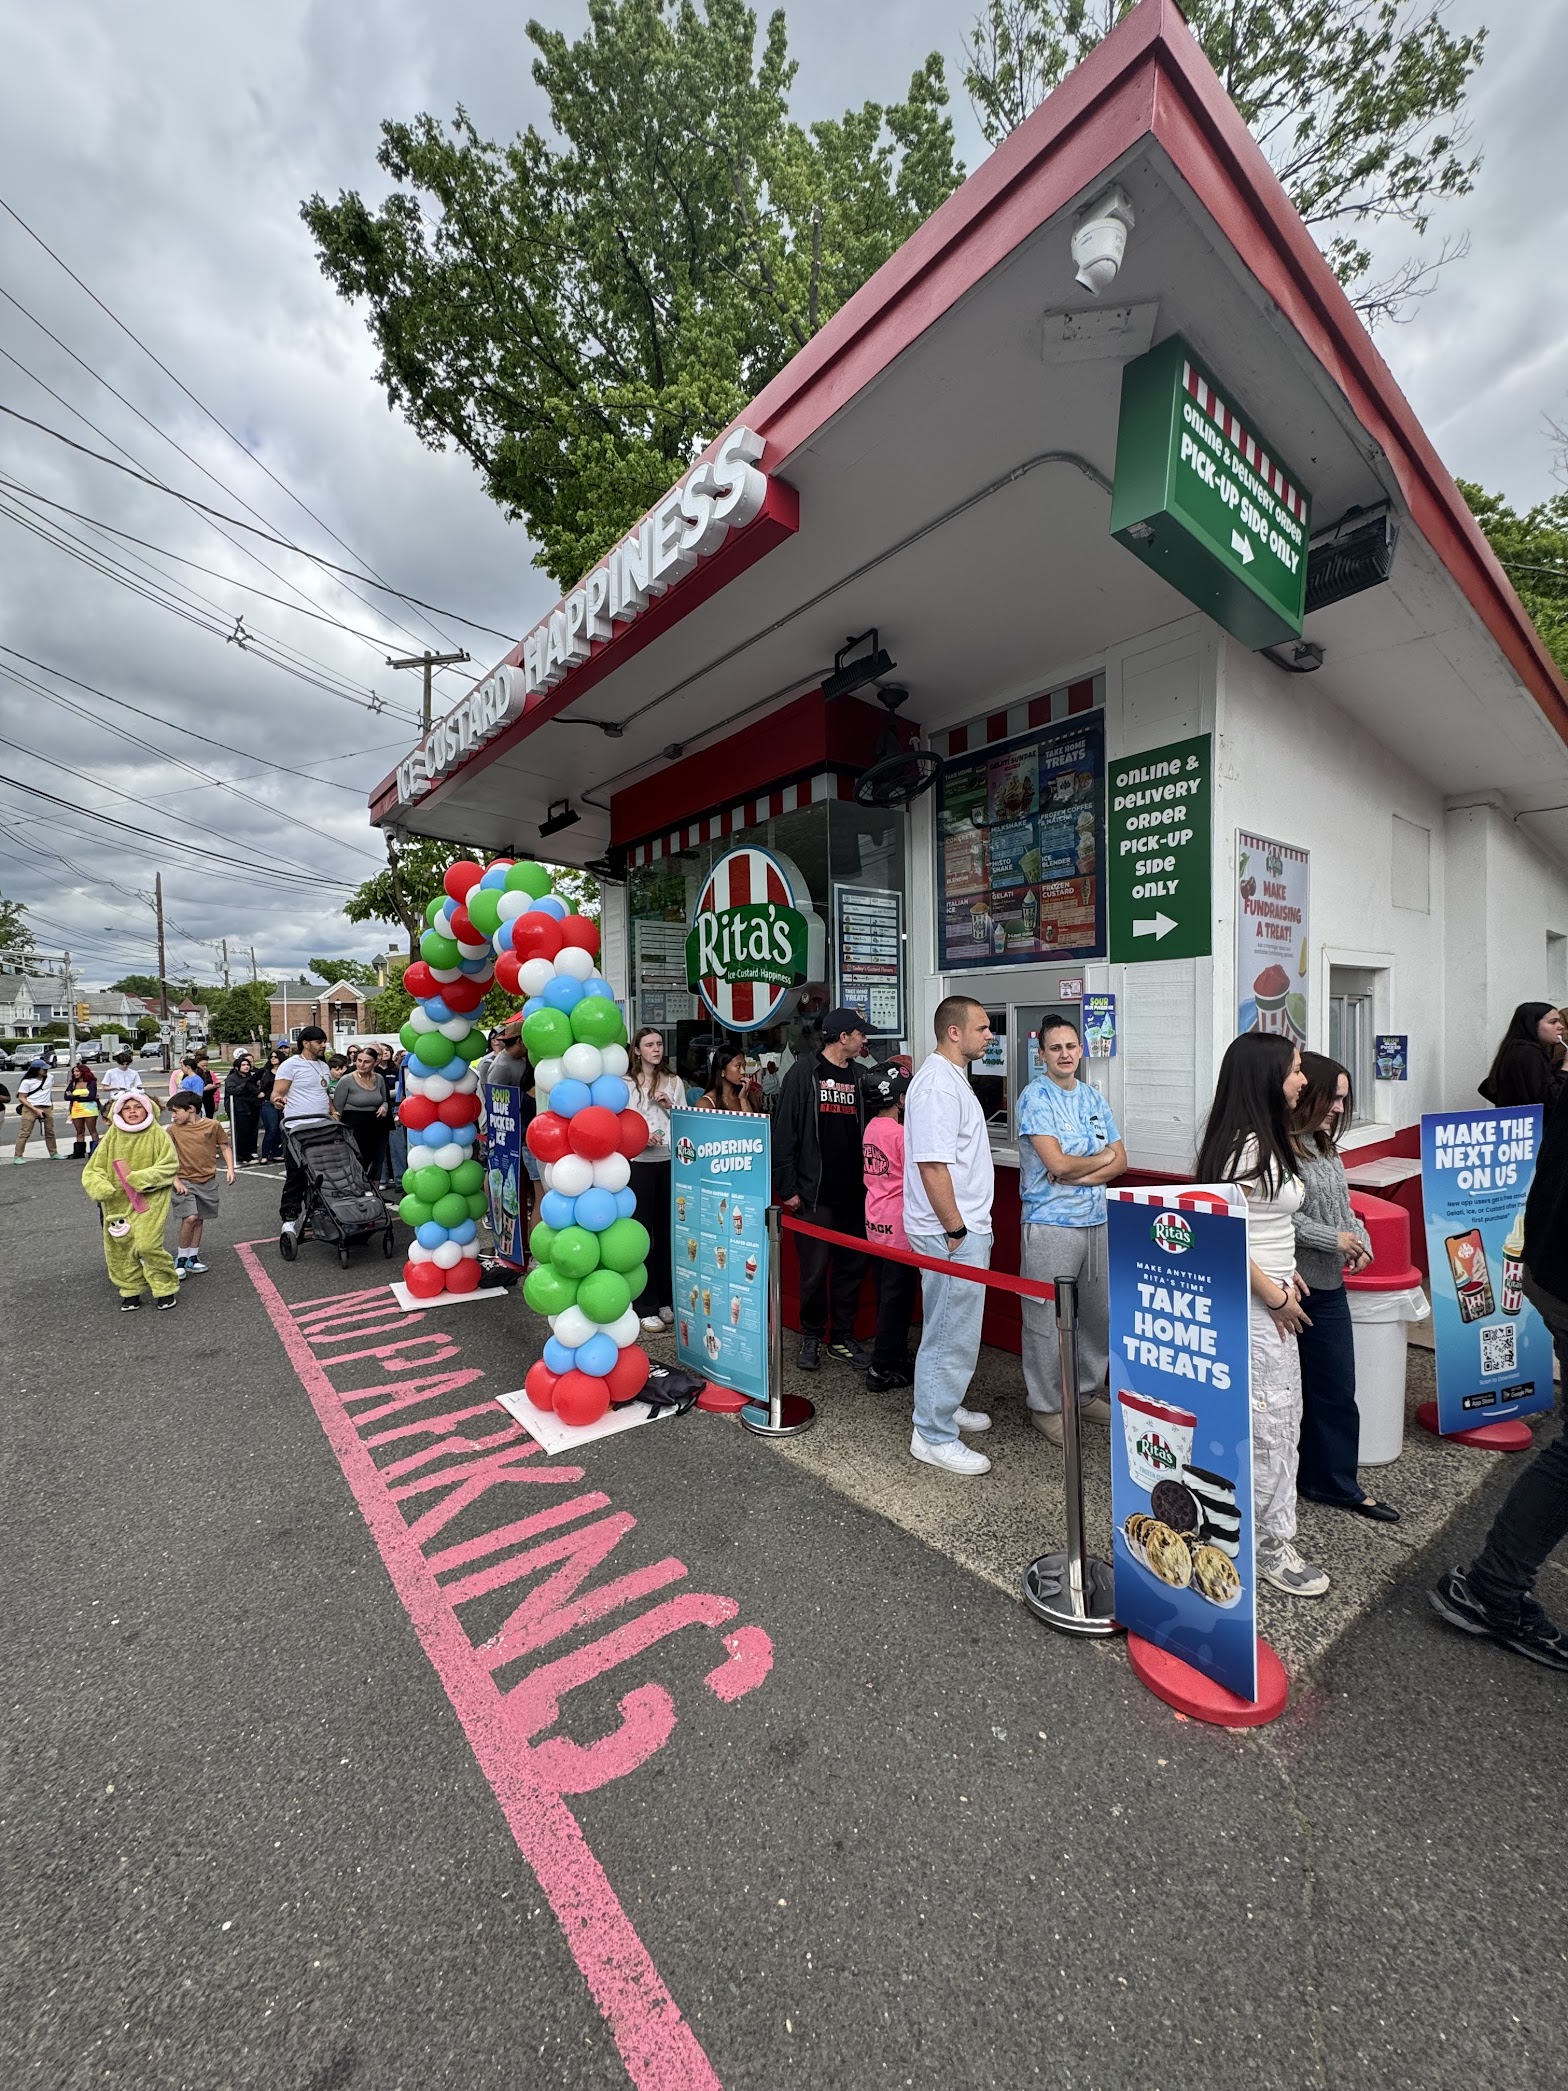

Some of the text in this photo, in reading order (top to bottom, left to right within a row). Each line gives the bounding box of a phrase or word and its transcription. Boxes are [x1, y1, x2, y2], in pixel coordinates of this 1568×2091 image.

[1222, 447, 1231, 466] &
[1180, 432, 1239, 510] PICK-UP
[396, 425, 767, 804] ICE CUSTARD HAPPINESS
[1010, 750, 1036, 765] SUNDAE
[1045, 739, 1086, 759] TAKE HOME
[1046, 748, 1086, 770] TREATS
[1185, 755, 1199, 771] &
[1040, 802, 1093, 821] FROZEN COFFEE
[990, 819, 1027, 833] MILKSHAKE
[945, 832, 976, 845] CONCRETE
[1120, 829, 1193, 856] PICK-UP
[1041, 854, 1052, 862] ICE
[1041, 857, 1071, 868] BLENDER
[991, 864, 1013, 873] SHAKE
[991, 891, 1014, 900] GELATI
[1042, 881, 1070, 892] FROZEN
[1042, 888, 1075, 898] CUSTARD
[1263, 880, 1287, 901] MAKE
[946, 899, 969, 907] ITALIAN
[946, 906, 956, 914] ICE
[1244, 899, 1302, 924] FUNDRAISING
[698, 904, 792, 976] Rita's
[1256, 921, 1292, 943] A TREAT!
[727, 971, 736, 980] Ice
[760, 968, 792, 985] Happiness
[845, 993, 868, 1002] TREATS
[1090, 997, 1109, 1006] SOUR
[981, 1058, 1005, 1066] WINDOW
[491, 1087, 511, 1104] SOUR
[493, 1101, 509, 1116] BLUE
[490, 1113, 515, 1132] PUCKER
[1435, 1117, 1534, 1146] MAKE THE
[496, 1132, 507, 1147] ICE
[697, 1138, 763, 1158] ORDERING
[677, 1145, 695, 1158] Rita's
[1435, 1139, 1534, 1170] NEXT ONE
[710, 1156, 753, 1174] GUIDE
[1457, 1163, 1517, 1190] ON US
[1155, 1223, 1191, 1243] Rita's
[1136, 1261, 1212, 1284] MAKE ANYTIME
[1143, 1273, 1204, 1293] RITA'S TIME
[1137, 1282, 1212, 1324] TAKE
[287, 1285, 427, 1343] NO
[1134, 1310, 1218, 1356] HOME
[1122, 1335, 1231, 1390] TREATS
[1511, 1390, 1524, 1398] Google
[1141, 1438, 1173, 1464] Rita's
[1139, 1466, 1156, 1478] FROZEN
[316, 1332, 775, 1795] PARKING
